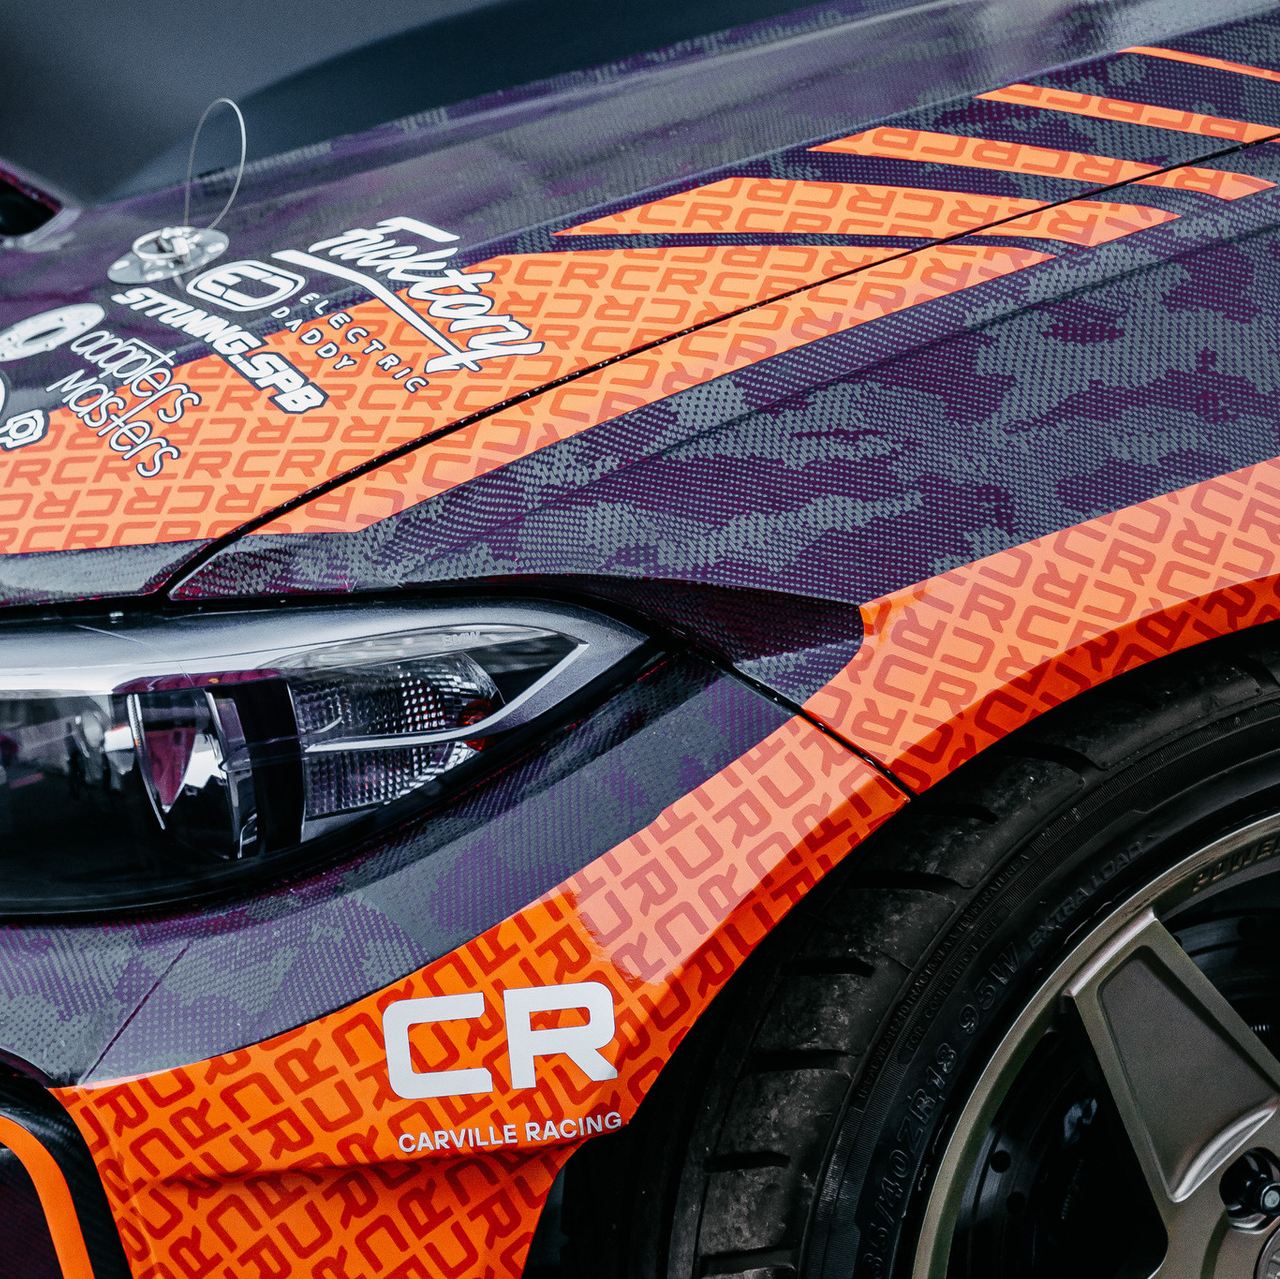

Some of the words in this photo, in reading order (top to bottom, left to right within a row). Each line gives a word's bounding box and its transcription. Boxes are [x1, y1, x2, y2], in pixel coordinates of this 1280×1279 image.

[271, 306, 356, 370] DADDY
[300, 293, 429, 393] ELECTRIC
[957, 941, 1022, 1035] 95W
[382, 981, 618, 1100] CR
[398, 1124, 518, 1153] CARVILLE
[525, 1111, 622, 1142] RACING
